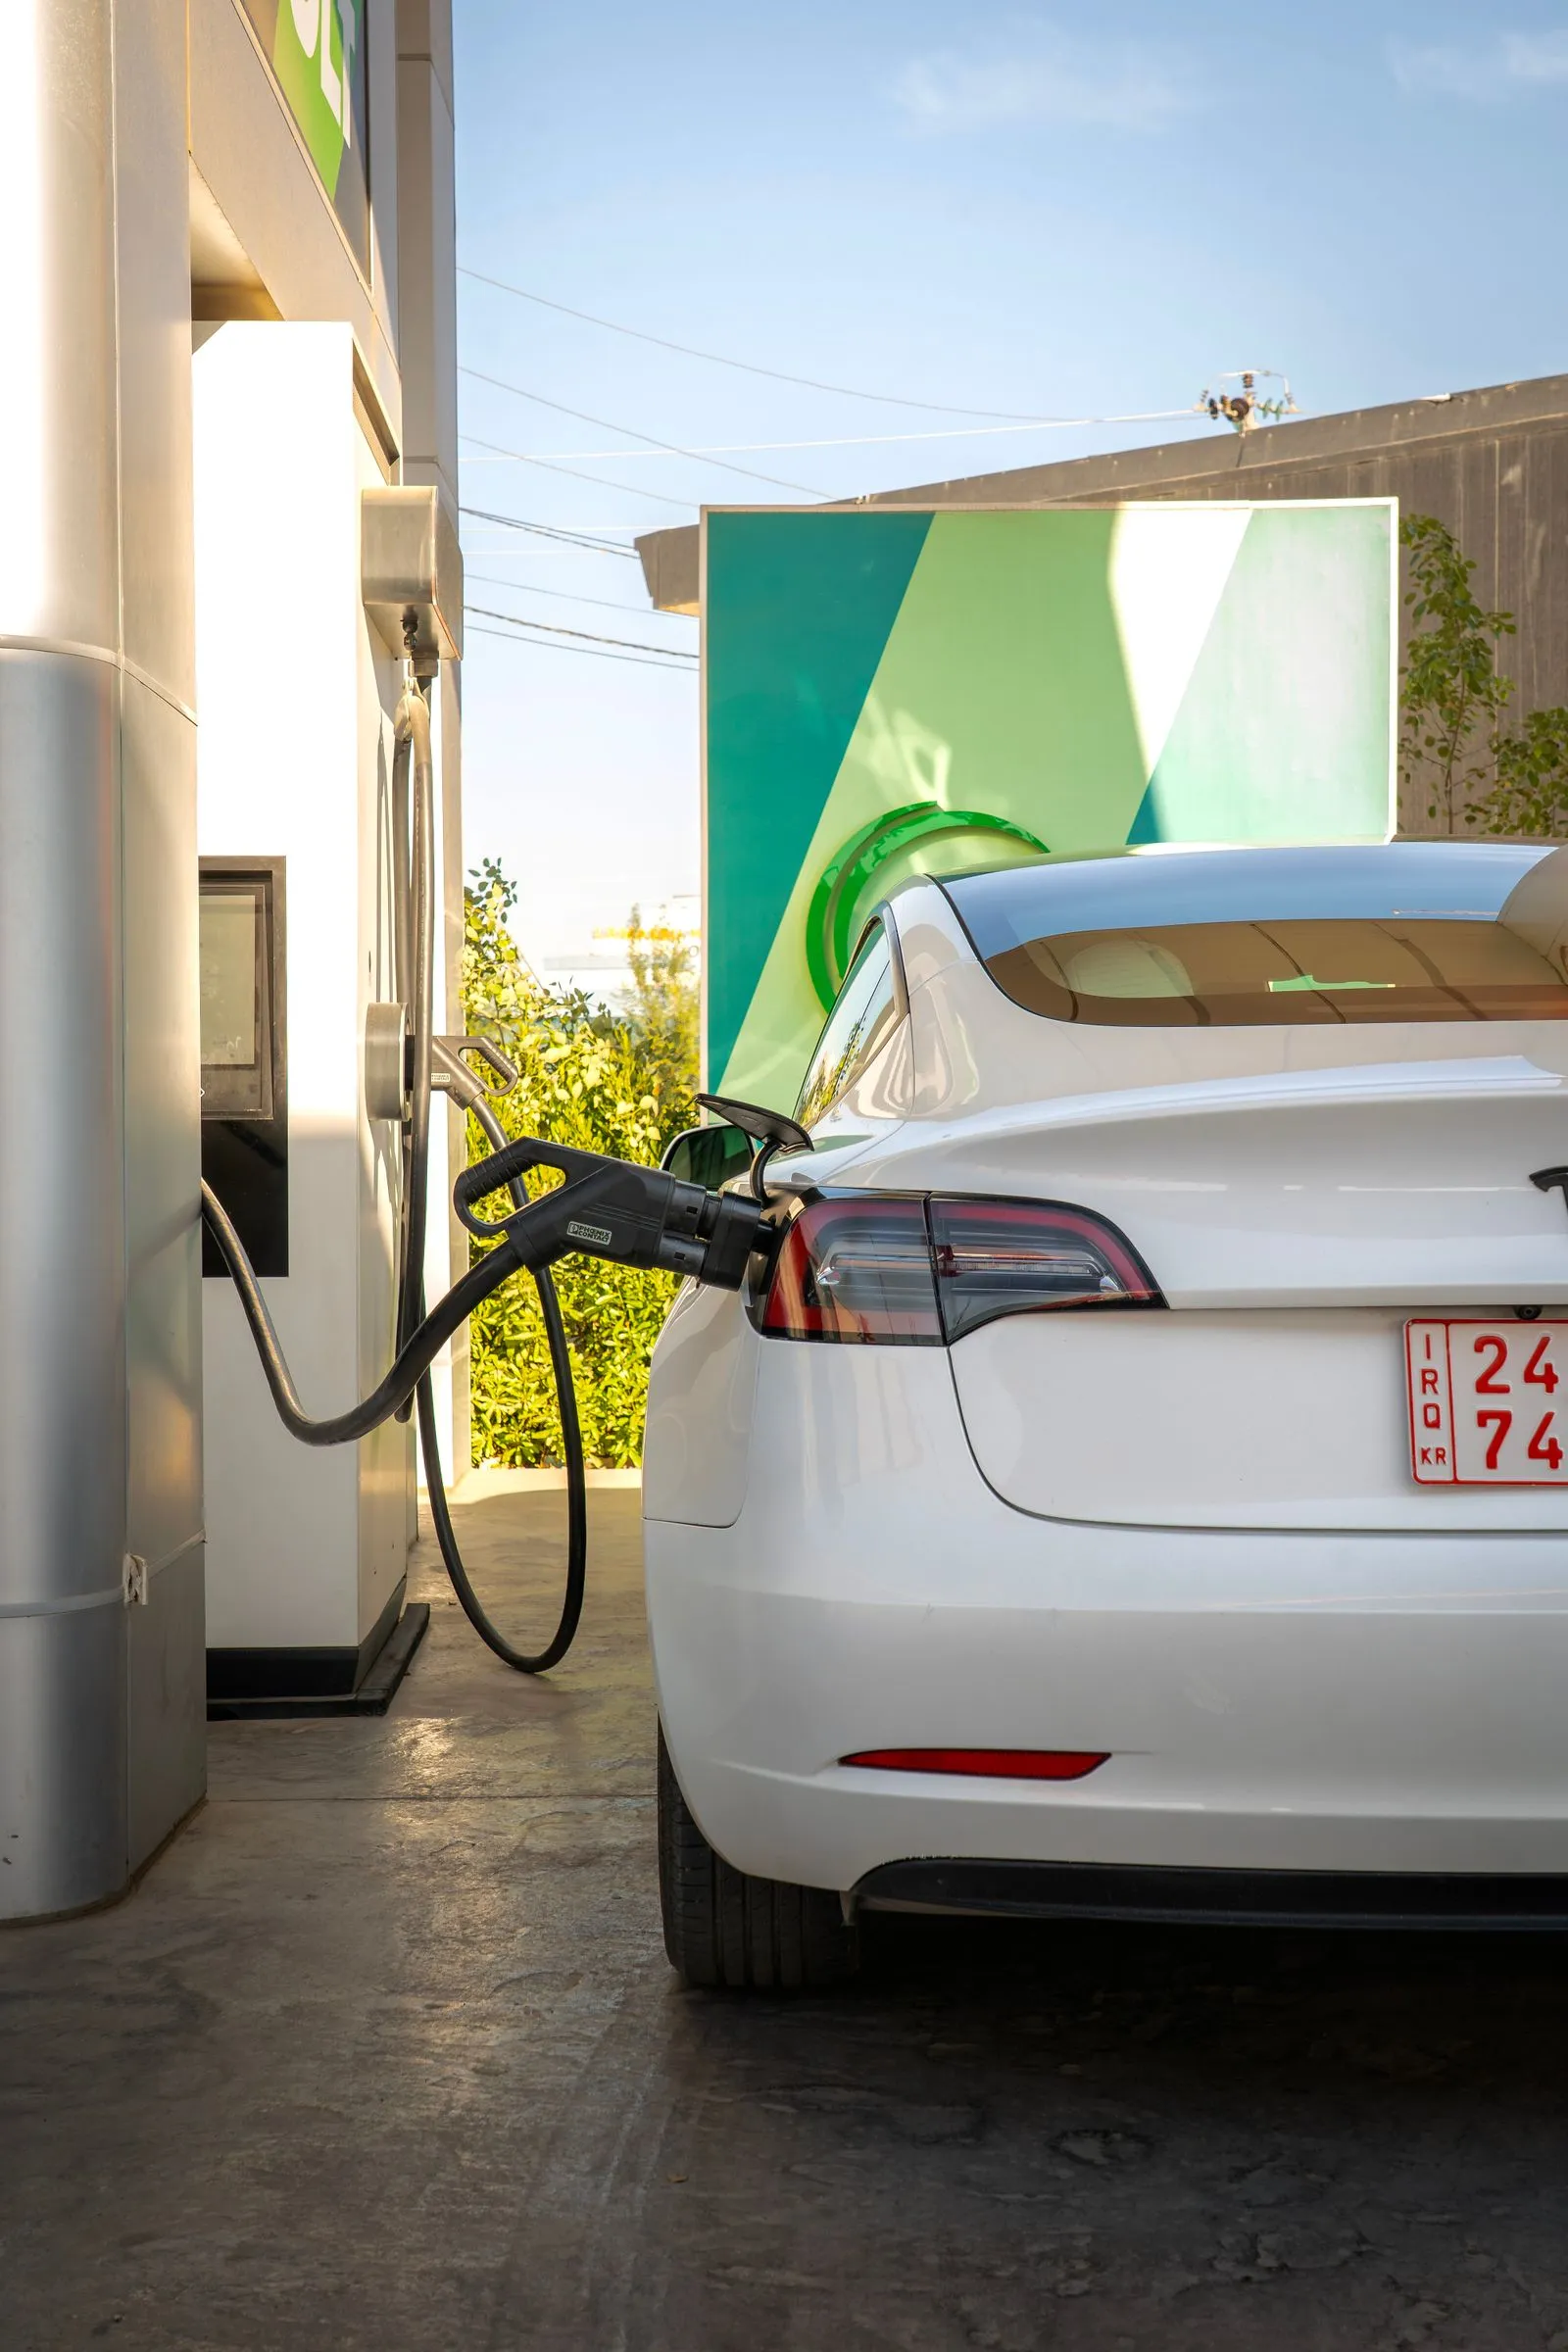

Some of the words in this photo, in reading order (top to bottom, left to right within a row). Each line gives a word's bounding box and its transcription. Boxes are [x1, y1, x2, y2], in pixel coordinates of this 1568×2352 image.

[1420, 1333, 1441, 1429] IRQ
[1474, 1335, 1559, 1394] 24
[1420, 1446, 1446, 1465] KR
[1477, 1410, 1563, 1470] 74
